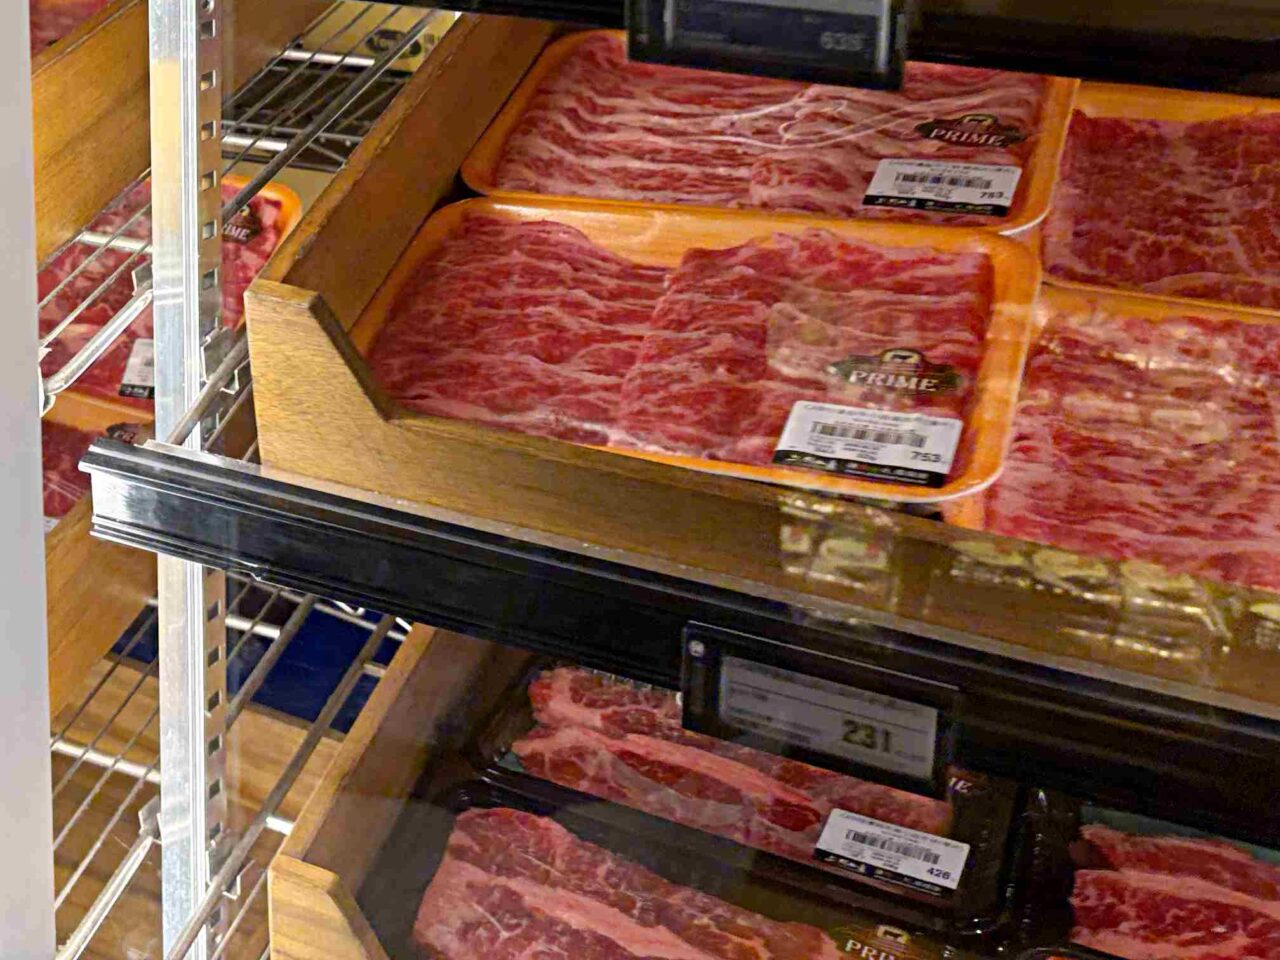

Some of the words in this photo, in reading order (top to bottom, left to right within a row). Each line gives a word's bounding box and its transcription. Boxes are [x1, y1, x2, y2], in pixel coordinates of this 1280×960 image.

[930, 128, 1006, 146] PRIME
[223, 223, 250, 240] IME
[848, 369, 939, 392] PRIME
[910, 450, 942, 463] 753
